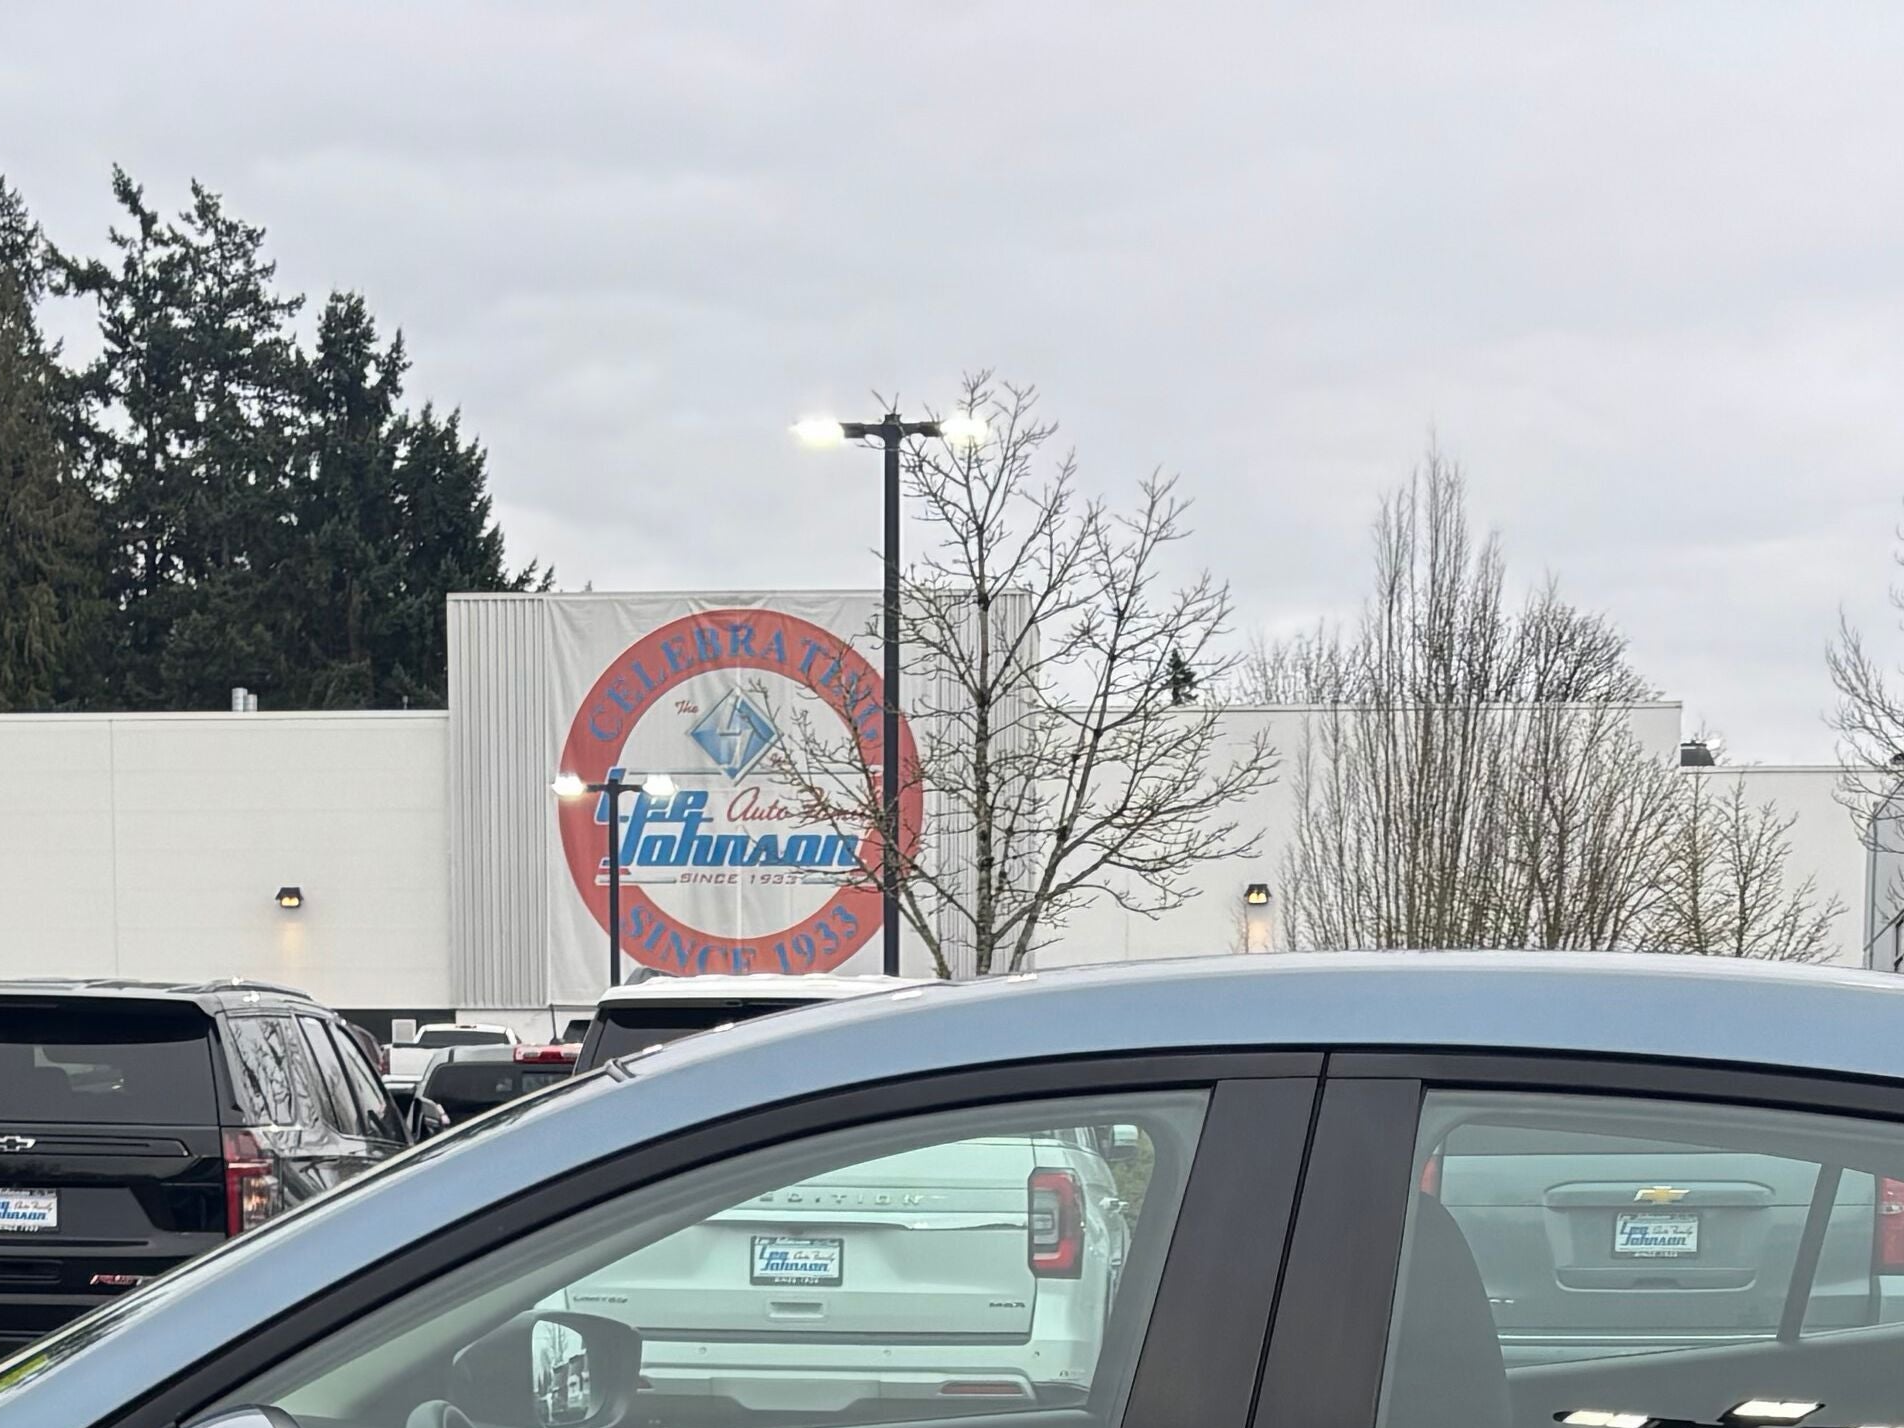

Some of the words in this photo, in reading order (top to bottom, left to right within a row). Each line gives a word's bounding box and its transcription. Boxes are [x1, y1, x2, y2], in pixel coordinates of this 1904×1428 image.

[594, 767, 714, 823] Lee
[726, 785, 789, 821] Auto
[600, 812, 868, 867] Johnson
[678, 872, 739, 885] SINCE
[749, 872, 801, 886] 1933
[622, 904, 756, 974] SINCE
[774, 903, 859, 974] 1933
